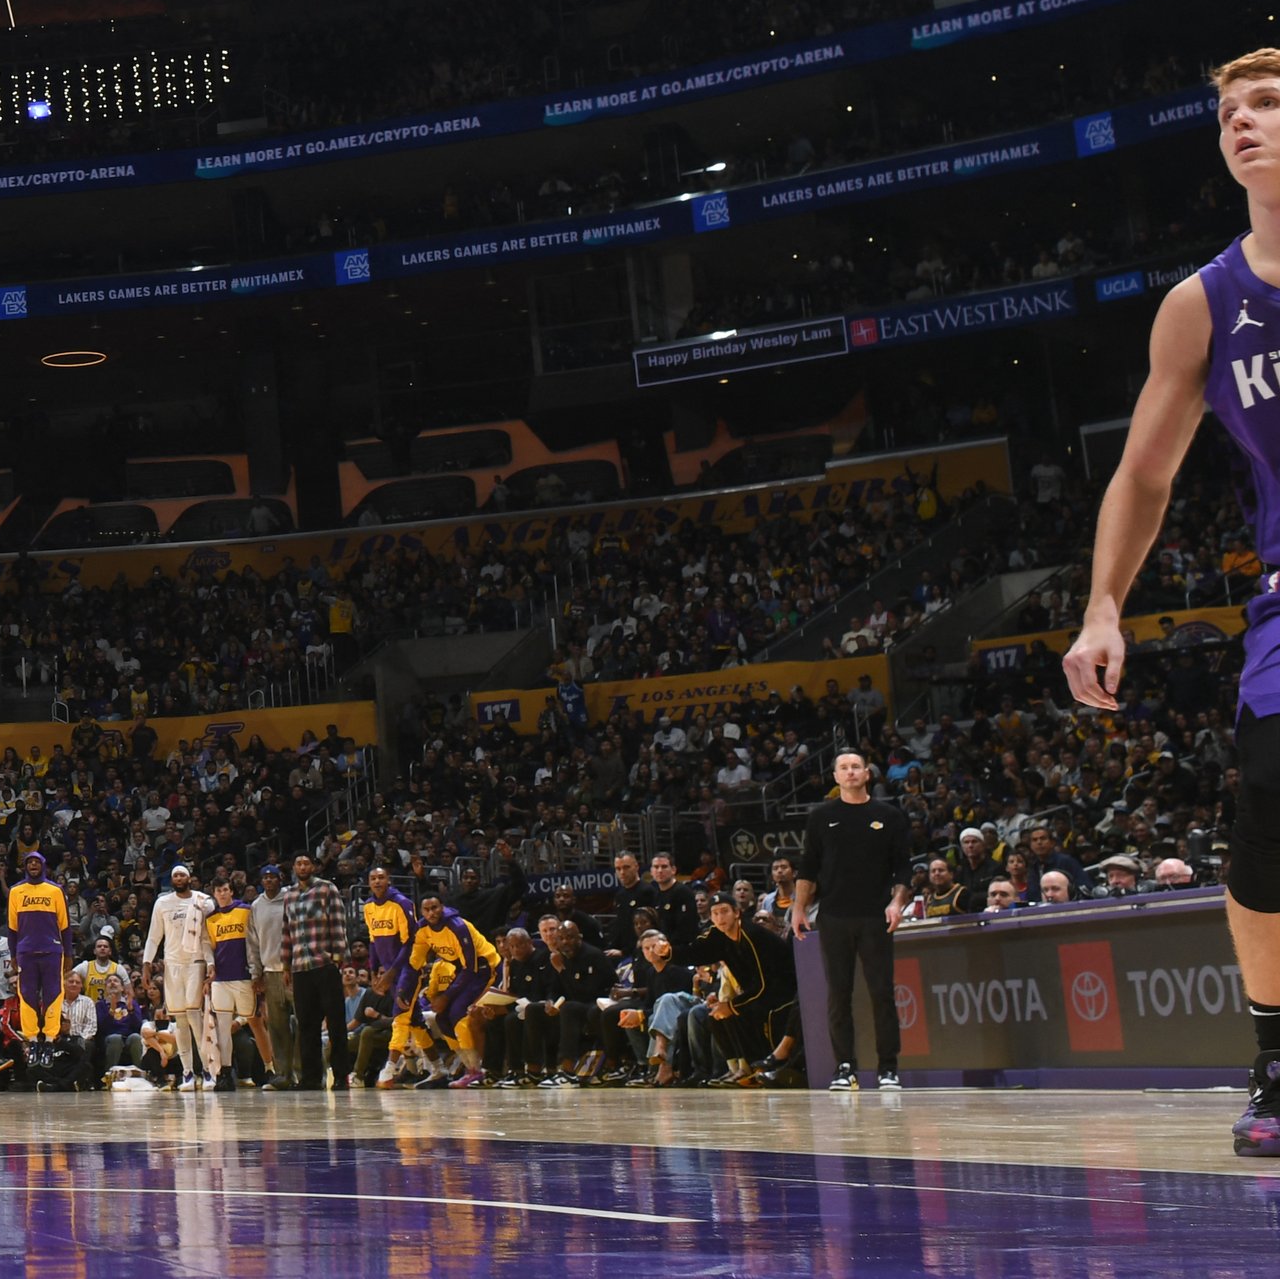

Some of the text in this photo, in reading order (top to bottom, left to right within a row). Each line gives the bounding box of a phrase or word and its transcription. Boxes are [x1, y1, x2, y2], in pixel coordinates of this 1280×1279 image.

[911, 16, 964, 41] LEARN
[967, 6, 1014, 29] MORE
[1016, 0, 1036, 18] AT
[545, 44, 844, 117] LEARN MORE AT GO.AMEX/CRYPTO-ARENA
[1149, 103, 1205, 127] LAKERS
[197, 116, 481, 170] LEARN MORE AT GO.AMEX/CRYPTO-ARENA
[762, 141, 1041, 209] LAKERS GAMES ARE BETTER #WITHAMEX
[401, 217, 661, 265] LAKERS GAMES ARE BETTER #WITHAMEX
[58, 269, 304, 304] LAKERS GAMES ARE BETTER #WITHAMEX
[1103, 279, 1138, 296] UCLA
[648, 325, 832, 370] Happy Birthday Wesley Lam
[987, 649, 1017, 669] 117
[483, 702, 512, 721] 117
[642, 681, 768, 704] LOS ANGELES
[22, 895, 51, 907] LAKERS
[216, 923, 245, 937] LAKERS
[932, 978, 1048, 1026] TOYOTA
[1127, 964, 1243, 1017] TOYOT
